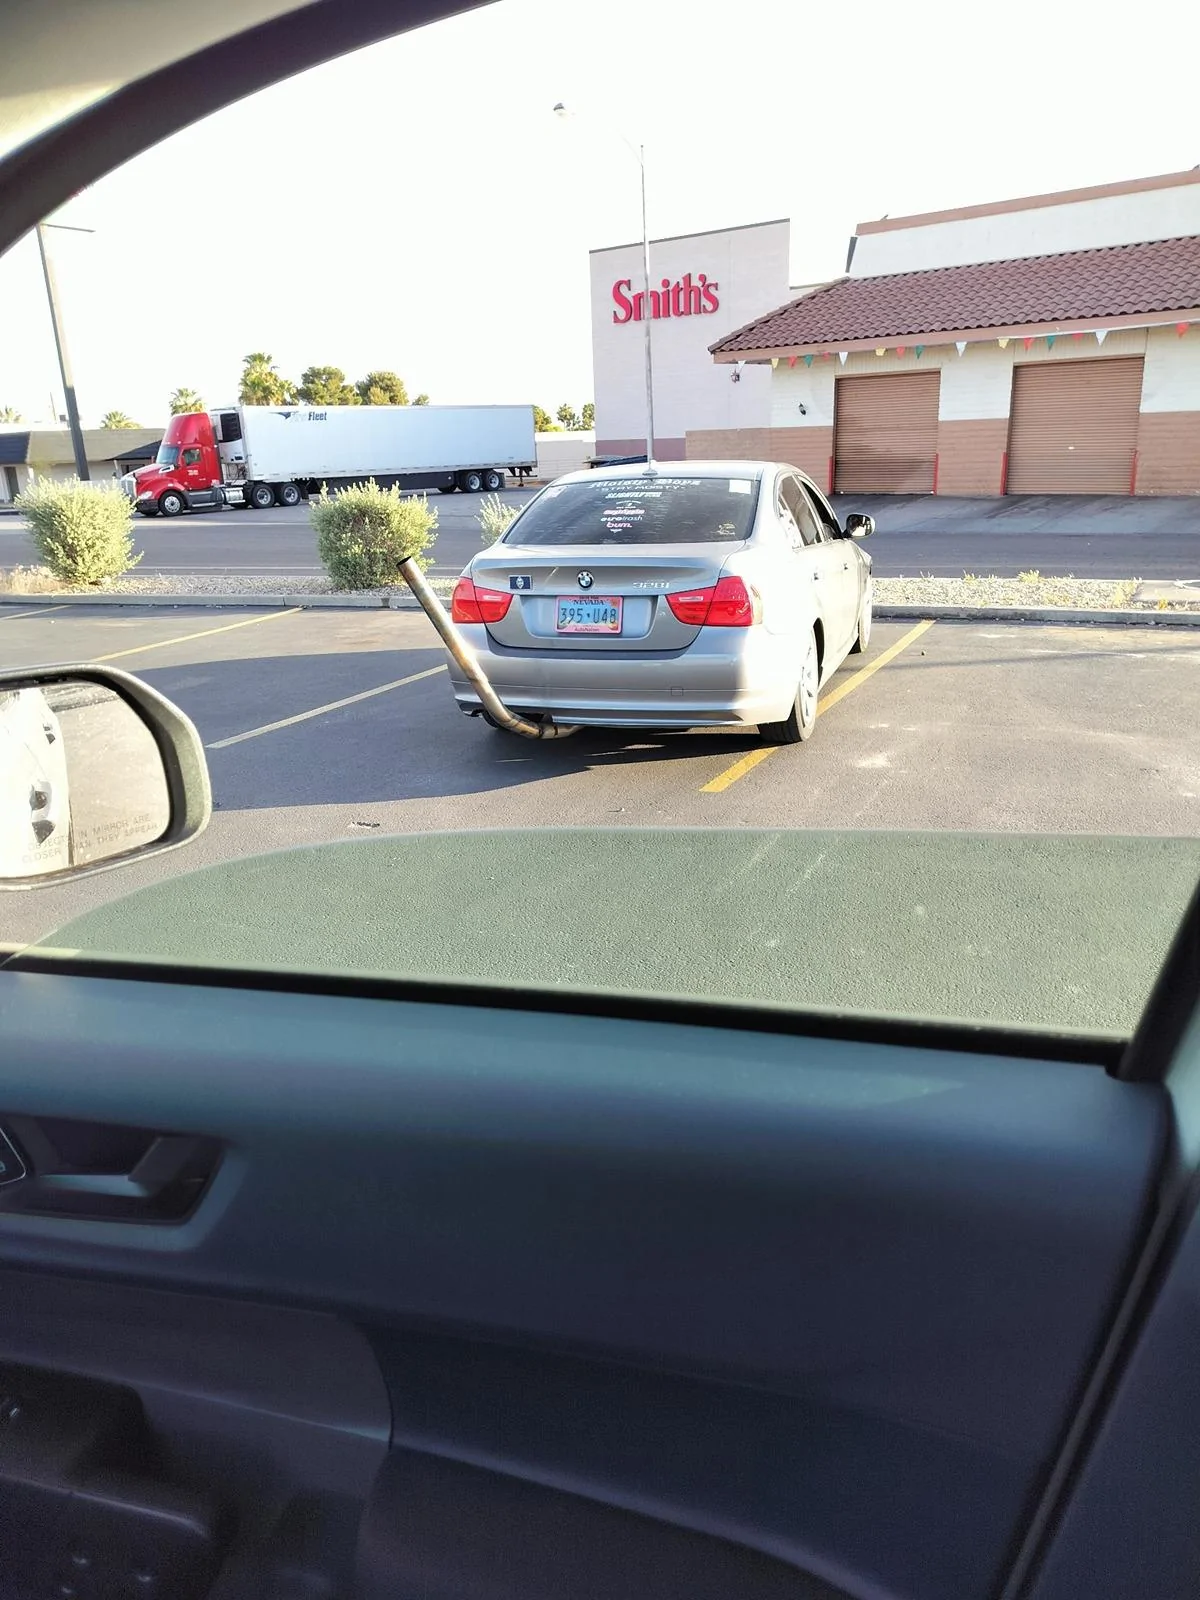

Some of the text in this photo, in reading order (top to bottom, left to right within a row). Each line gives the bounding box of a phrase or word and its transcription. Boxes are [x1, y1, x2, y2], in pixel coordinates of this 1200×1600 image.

[612, 273, 719, 323] Smith's
[308, 411, 327, 421] Fleet
[78, 829, 88, 838] IN
[93, 821, 129, 835] MIRROR
[133, 814, 150, 825] ARE
[97, 834, 120, 847] THEY
[125, 824, 158, 837] APPEAR
